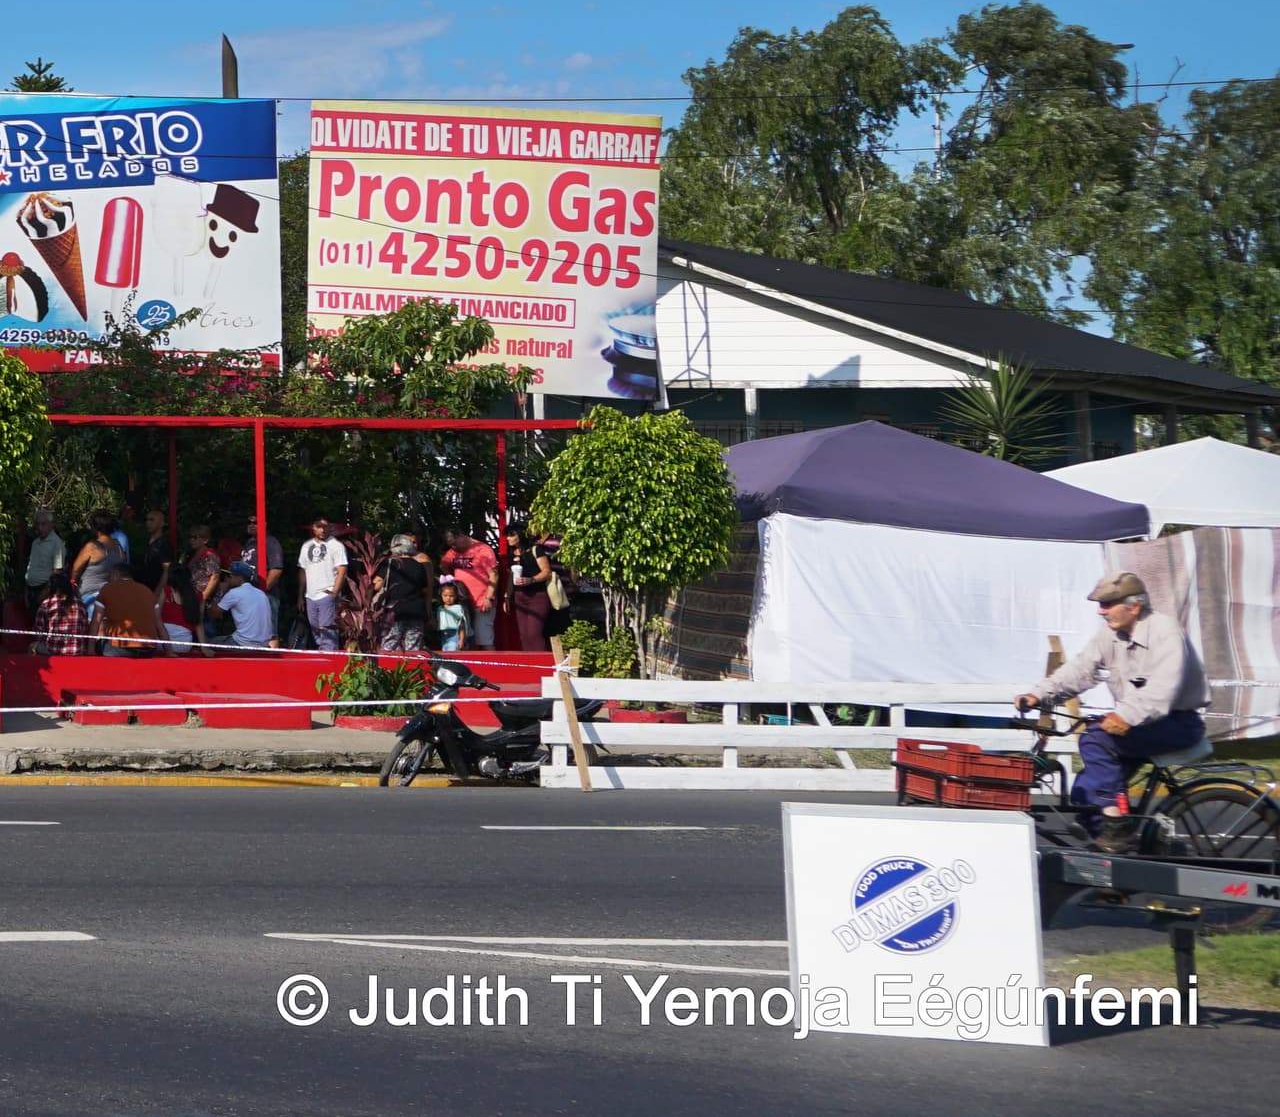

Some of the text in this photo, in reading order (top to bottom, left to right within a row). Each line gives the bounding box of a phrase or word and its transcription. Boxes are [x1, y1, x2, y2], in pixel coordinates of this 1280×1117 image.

[62, 111, 202, 164] FRIO
[311, 117, 417, 151] OLVIDATE
[425, 123, 452, 153] DE
[459, 124, 488, 155] TU
[496, 126, 563, 159] VIEJA
[21, 157, 199, 182] HELADOS
[318, 158, 656, 238] Pronto Gas
[319, 232, 641, 289] (011) 4250-9205
[506, 337, 573, 359] natural
[855, 861, 916, 898] FOOD TRUCK
[832, 859, 976, 953] DUMAS 300
